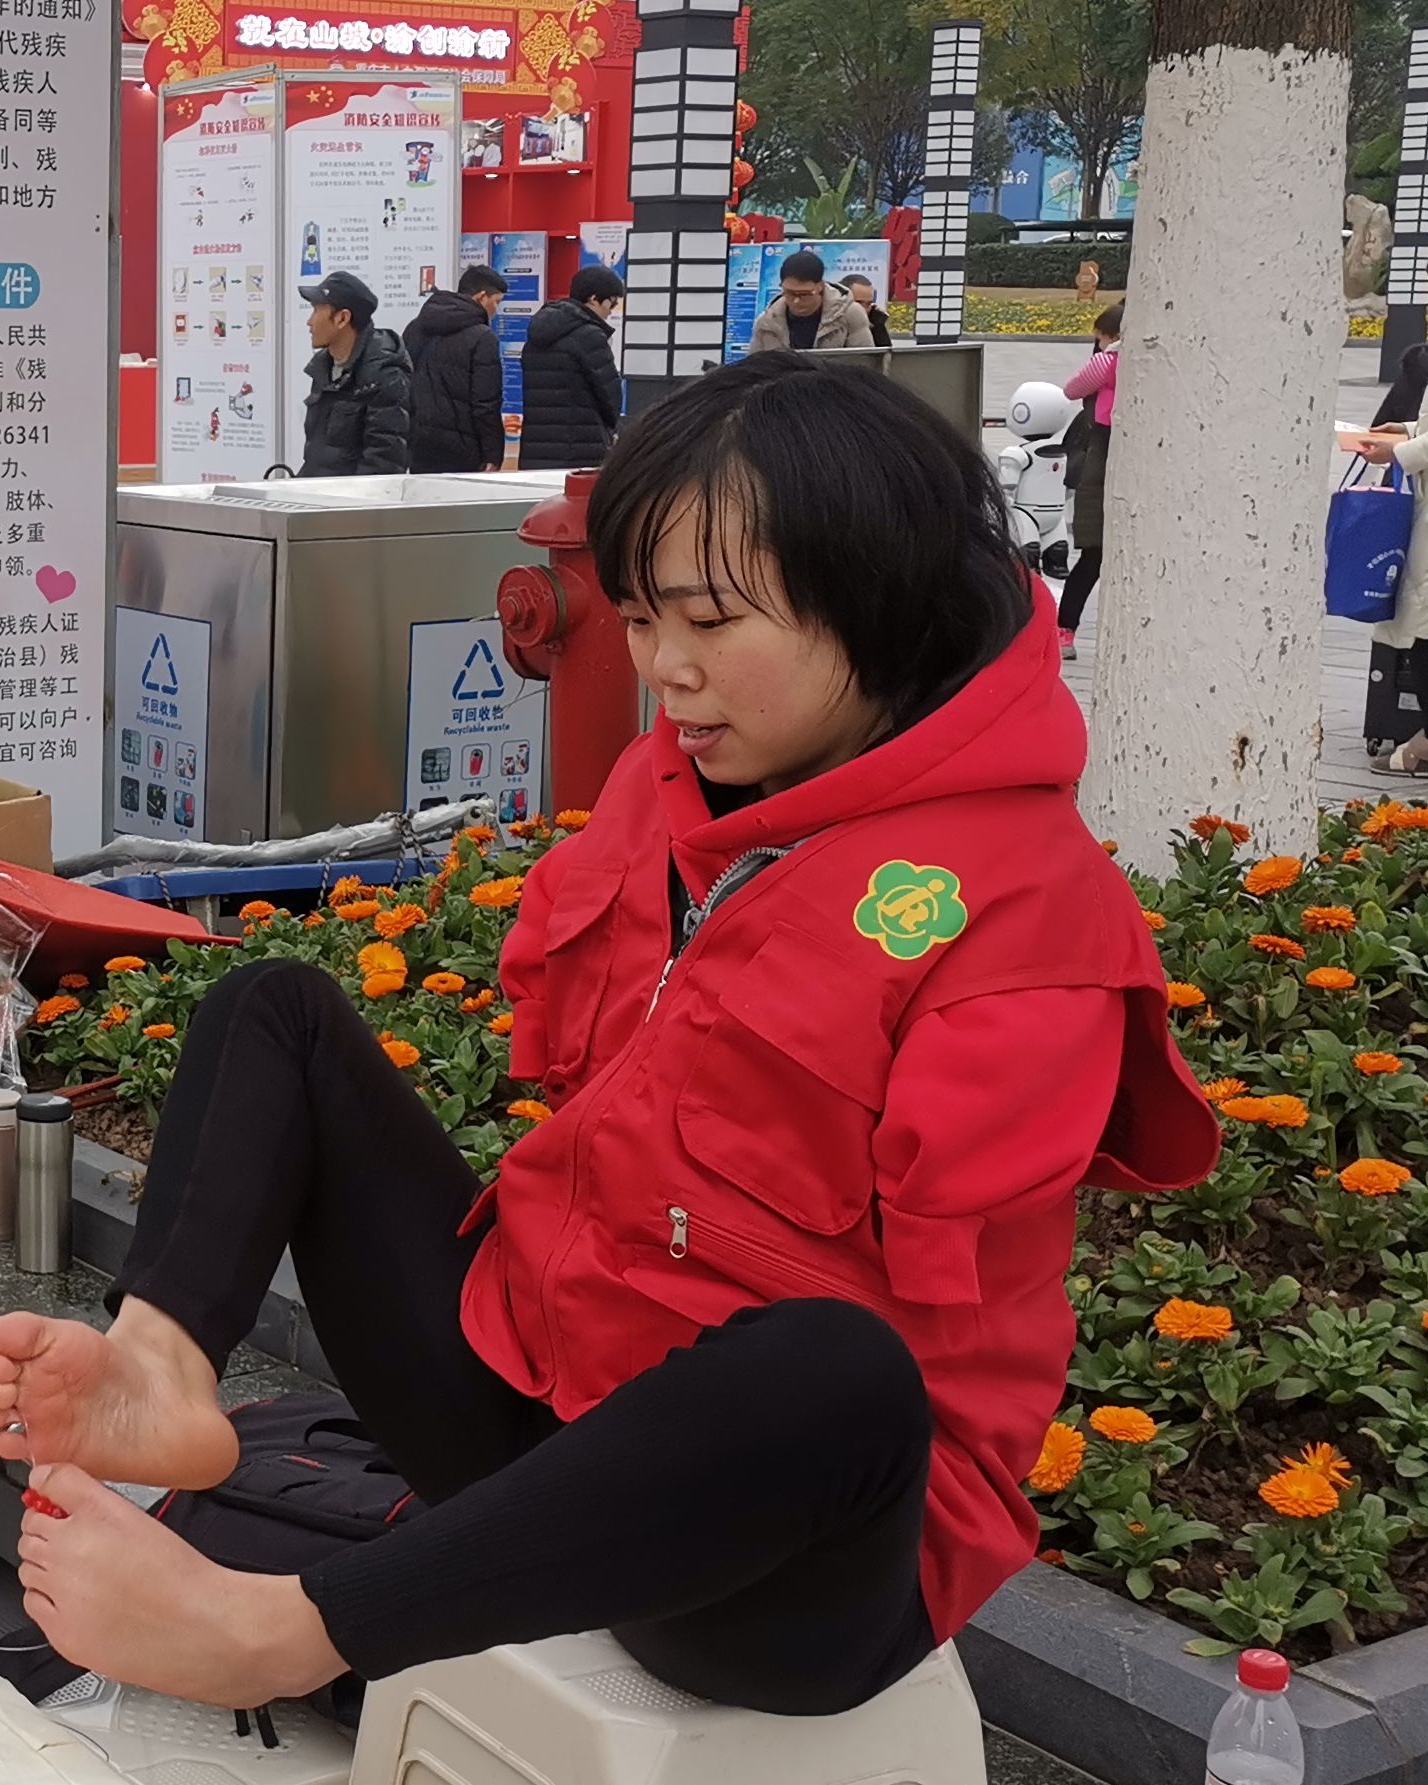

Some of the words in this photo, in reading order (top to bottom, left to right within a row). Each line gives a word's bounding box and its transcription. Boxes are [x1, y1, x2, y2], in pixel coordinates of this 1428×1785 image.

[141, 696, 178, 719] 可回收物
[443, 723, 485, 736] Recyclable
[486, 722, 510, 732] waste
